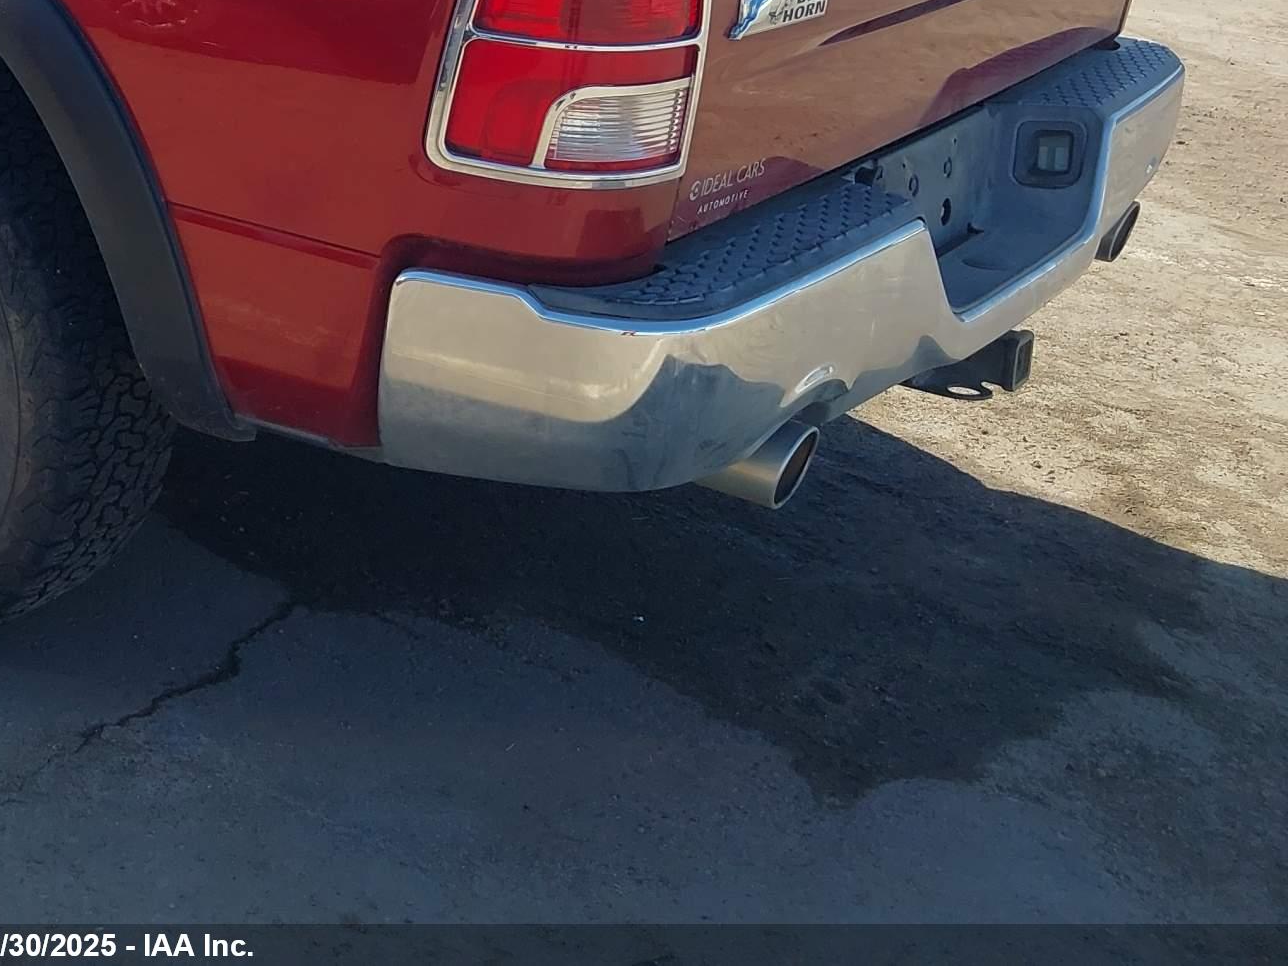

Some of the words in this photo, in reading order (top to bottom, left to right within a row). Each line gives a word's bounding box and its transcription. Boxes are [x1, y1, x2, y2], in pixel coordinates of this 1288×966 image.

[782, 0, 826, 23] HORN
[701, 169, 733, 197] IDEAL
[736, 157, 766, 183] CARS
[697, 189, 749, 215] AUTOMOTIVE
